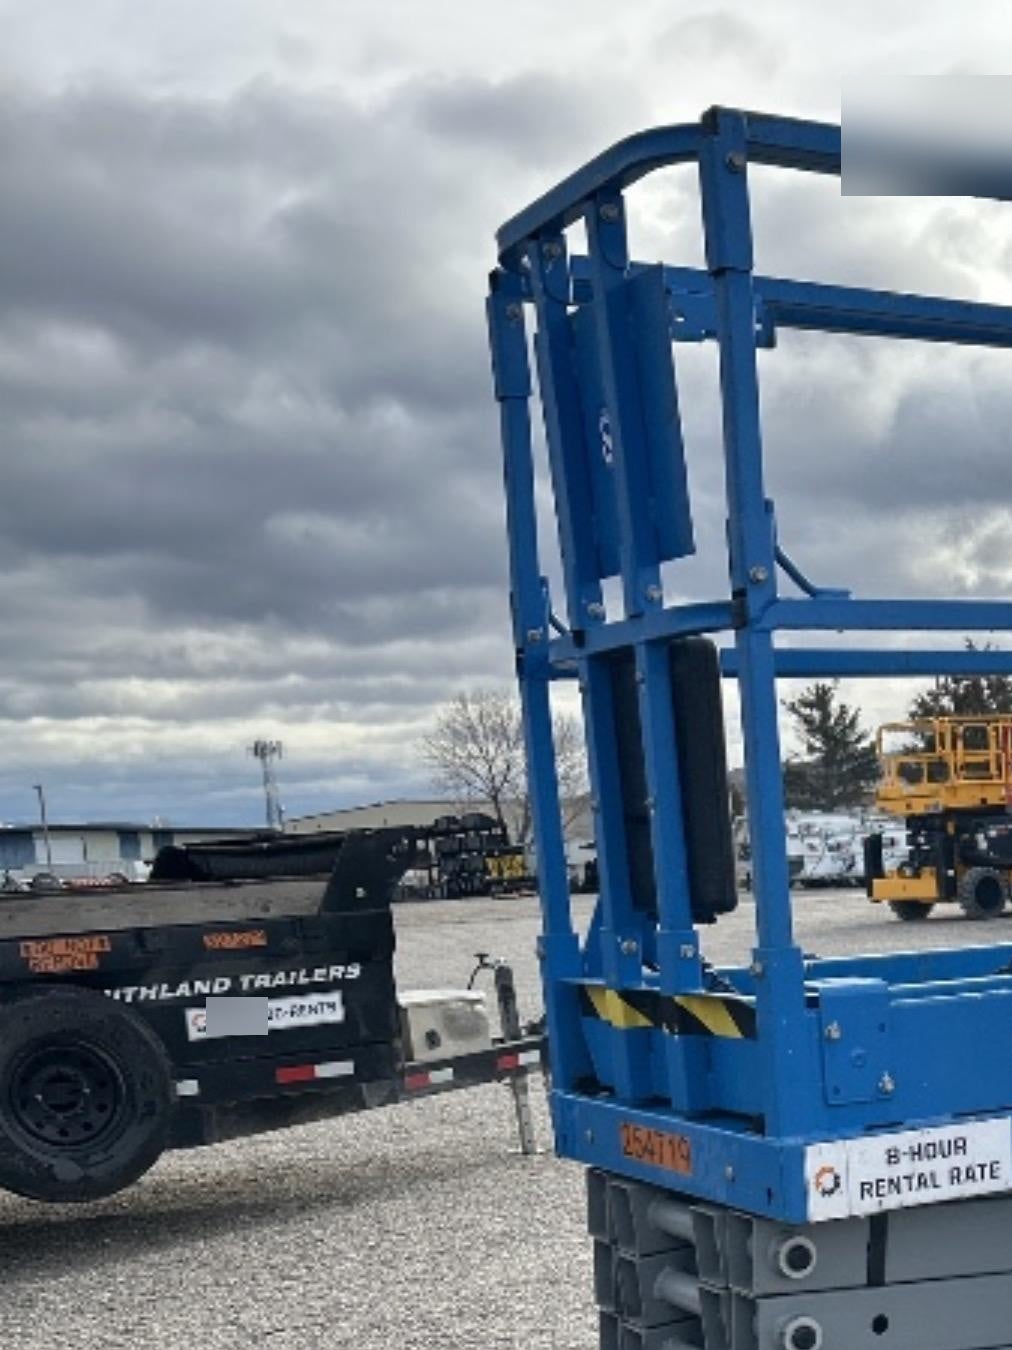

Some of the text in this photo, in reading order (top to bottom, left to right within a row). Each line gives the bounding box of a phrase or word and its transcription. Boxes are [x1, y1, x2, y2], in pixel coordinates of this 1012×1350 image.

[240, 962, 362, 991] TRAILERS
[623, 1123, 690, 1172] 254719
[885, 1136, 968, 1165] 8-HOUR
[860, 1160, 1002, 1200] RENTAL RATE
